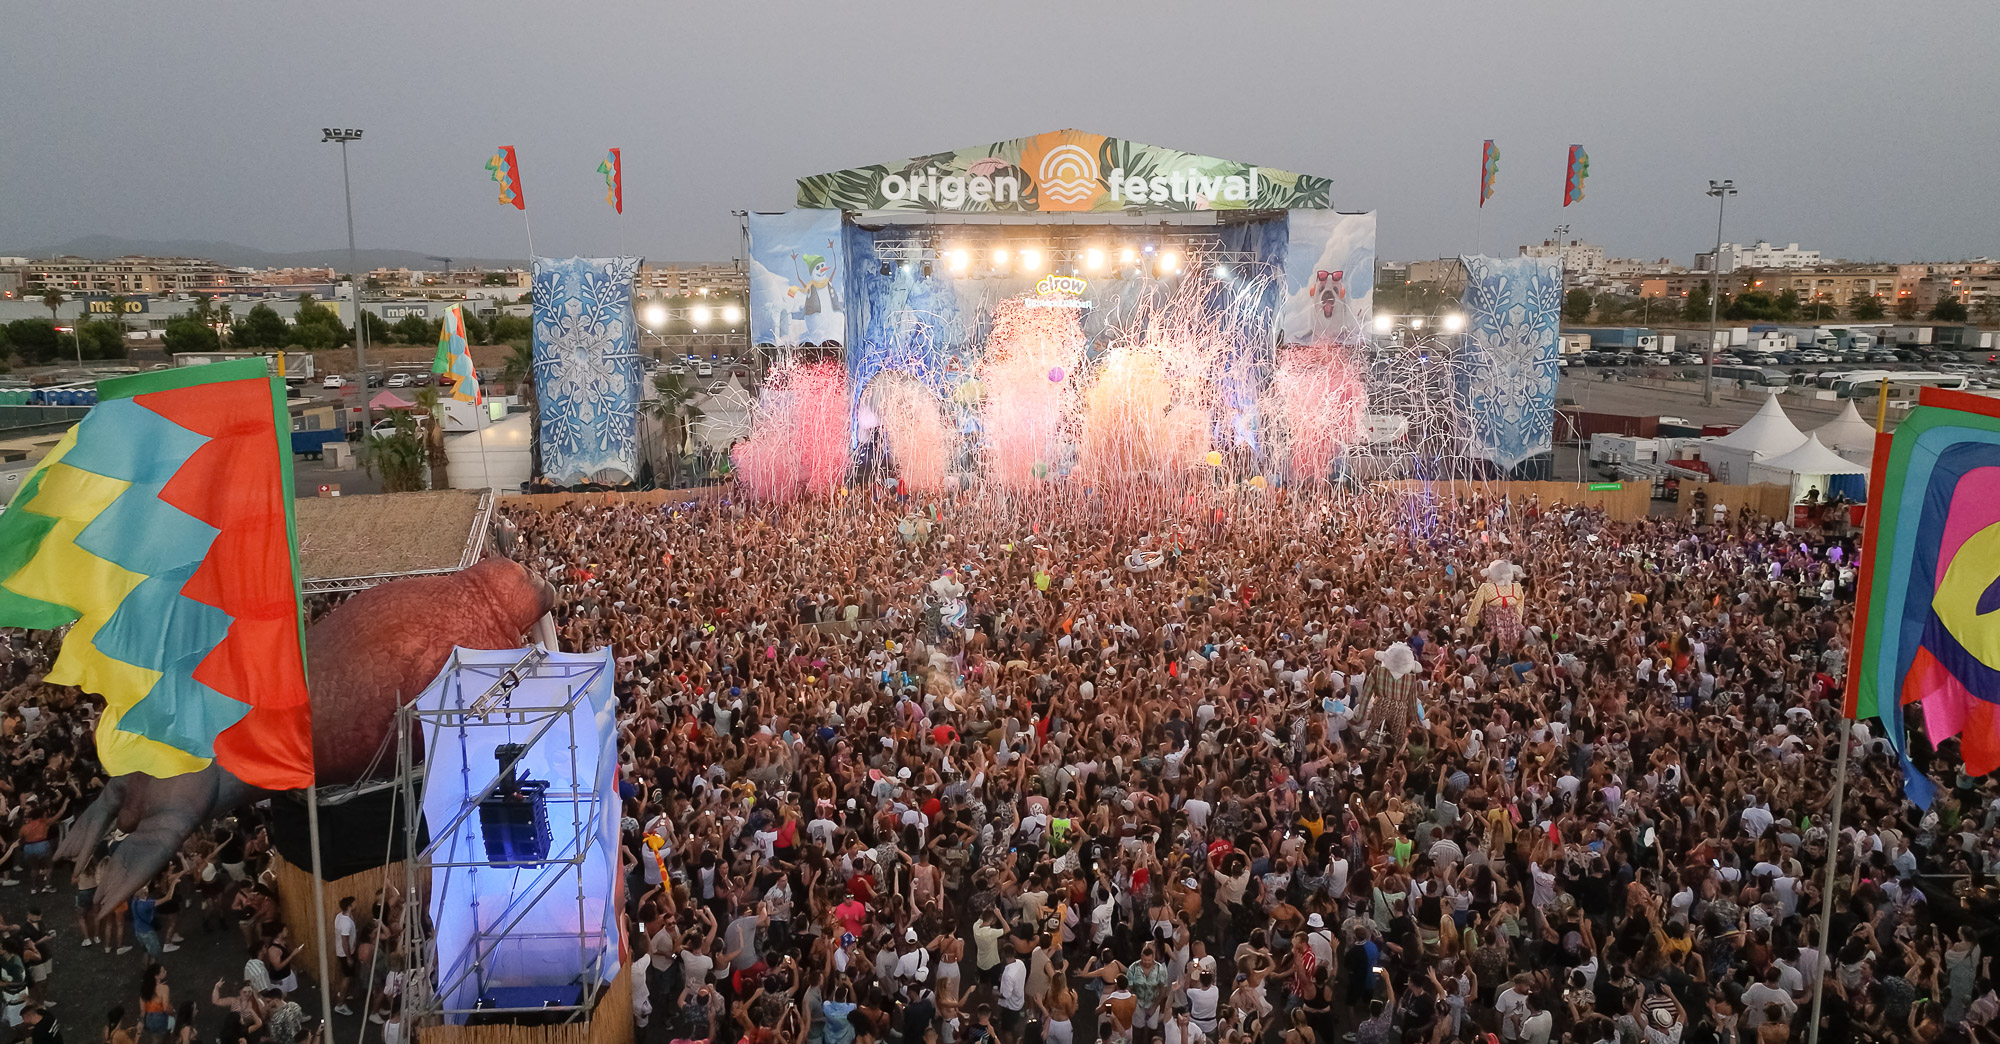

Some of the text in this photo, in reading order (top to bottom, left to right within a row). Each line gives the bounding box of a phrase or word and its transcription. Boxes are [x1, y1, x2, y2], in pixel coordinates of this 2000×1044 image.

[880, 166, 1258, 208] origen festival
[1037, 275, 1086, 294] elrow
[89, 300, 143, 313] maro
[387, 306, 425, 317] makro
